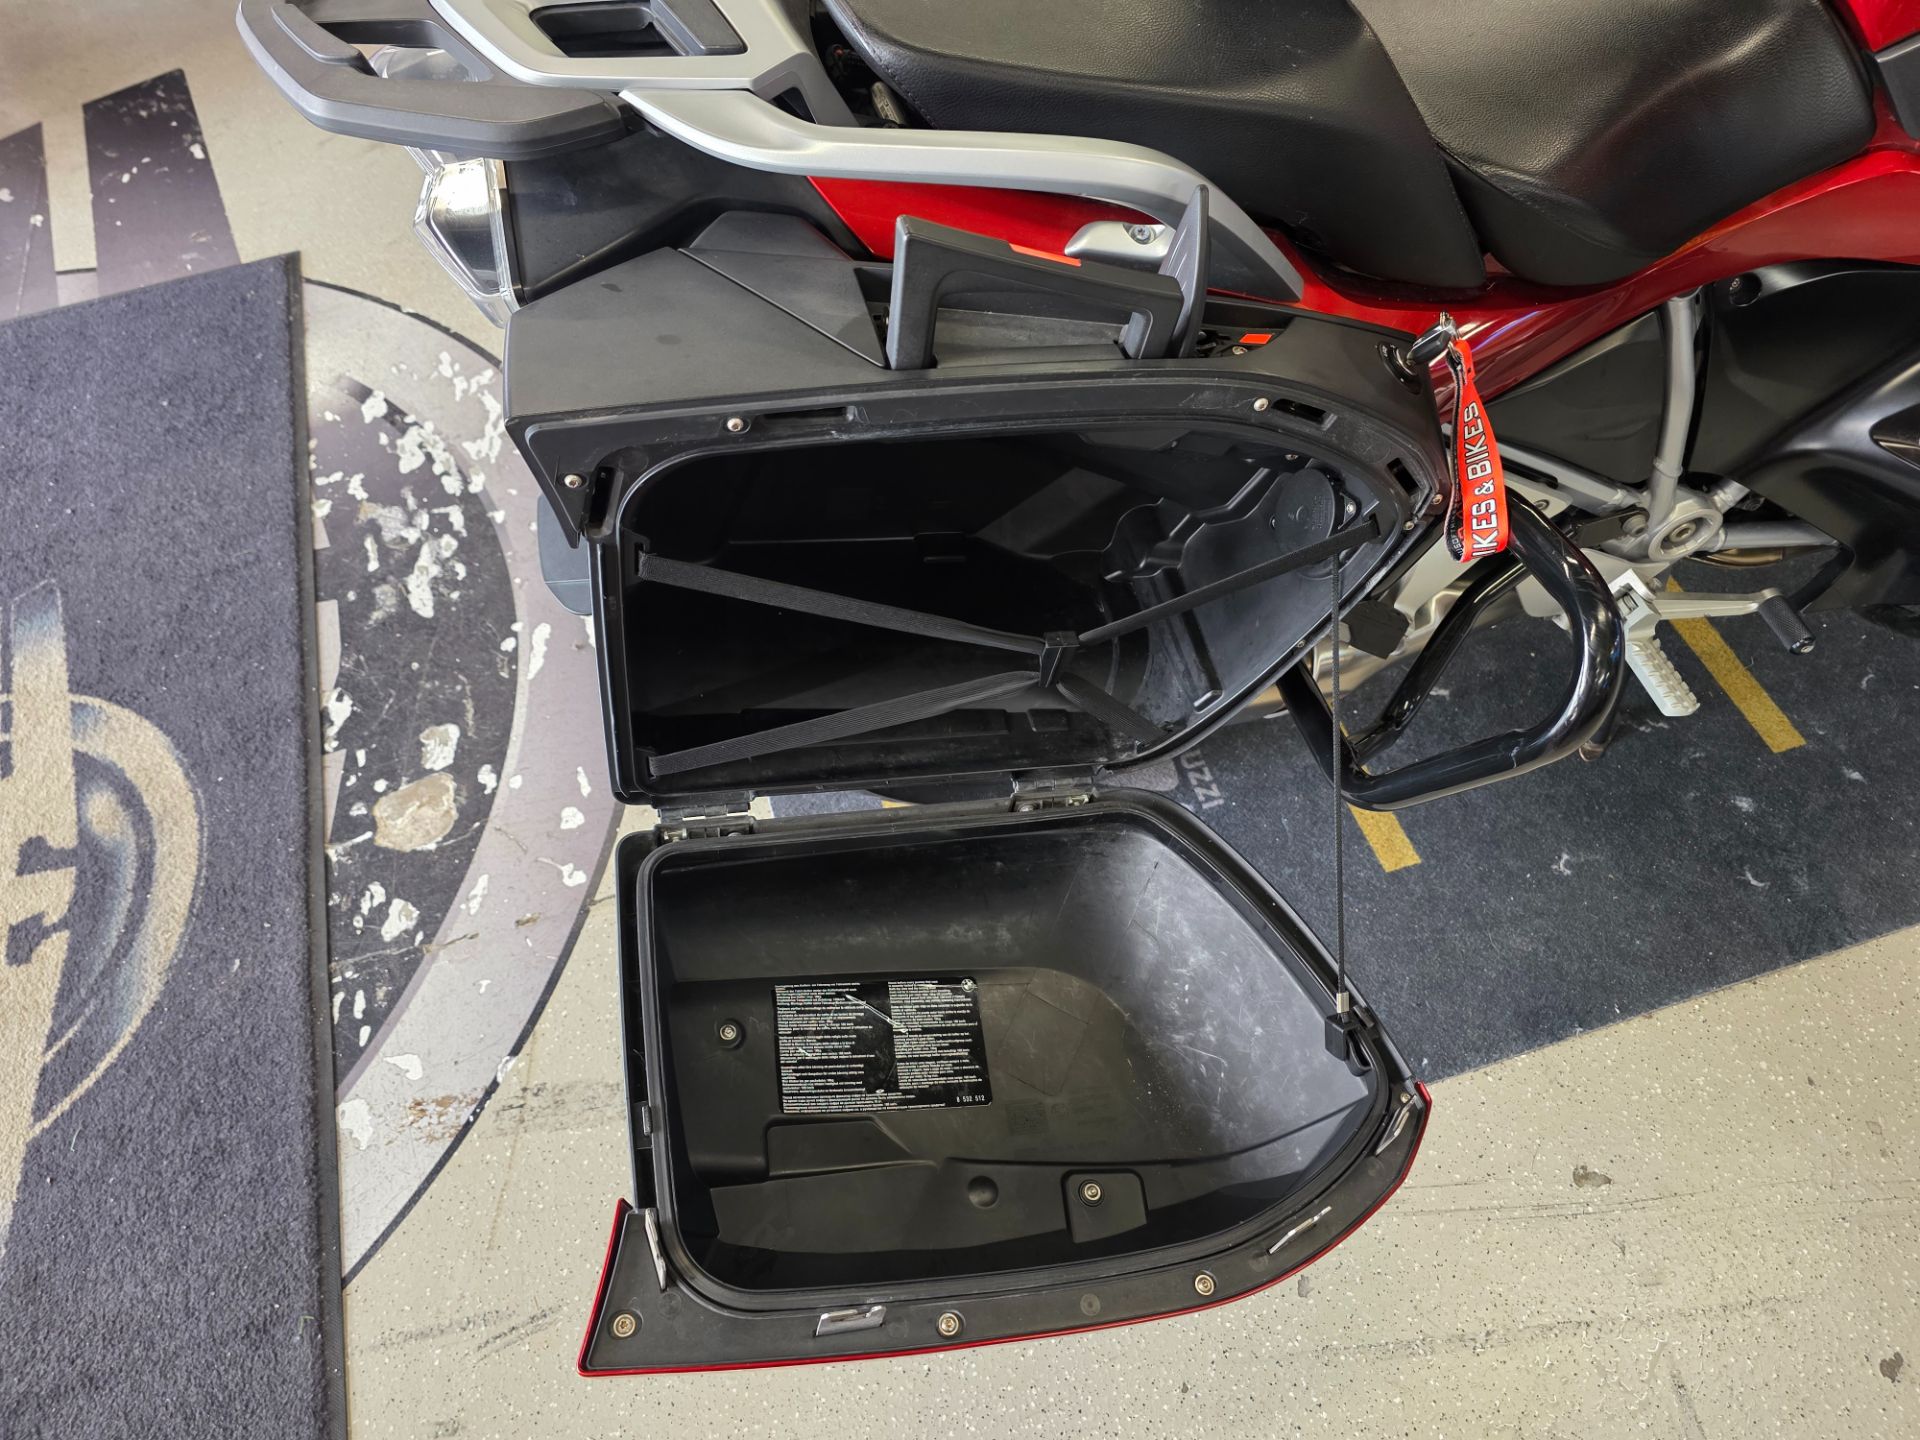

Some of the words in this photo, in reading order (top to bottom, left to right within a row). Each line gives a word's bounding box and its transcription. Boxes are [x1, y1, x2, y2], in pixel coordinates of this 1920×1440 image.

[1463, 400, 1493, 481] BIKES
[1474, 479, 1495, 495] &
[974, 1094, 985, 1102] 512
